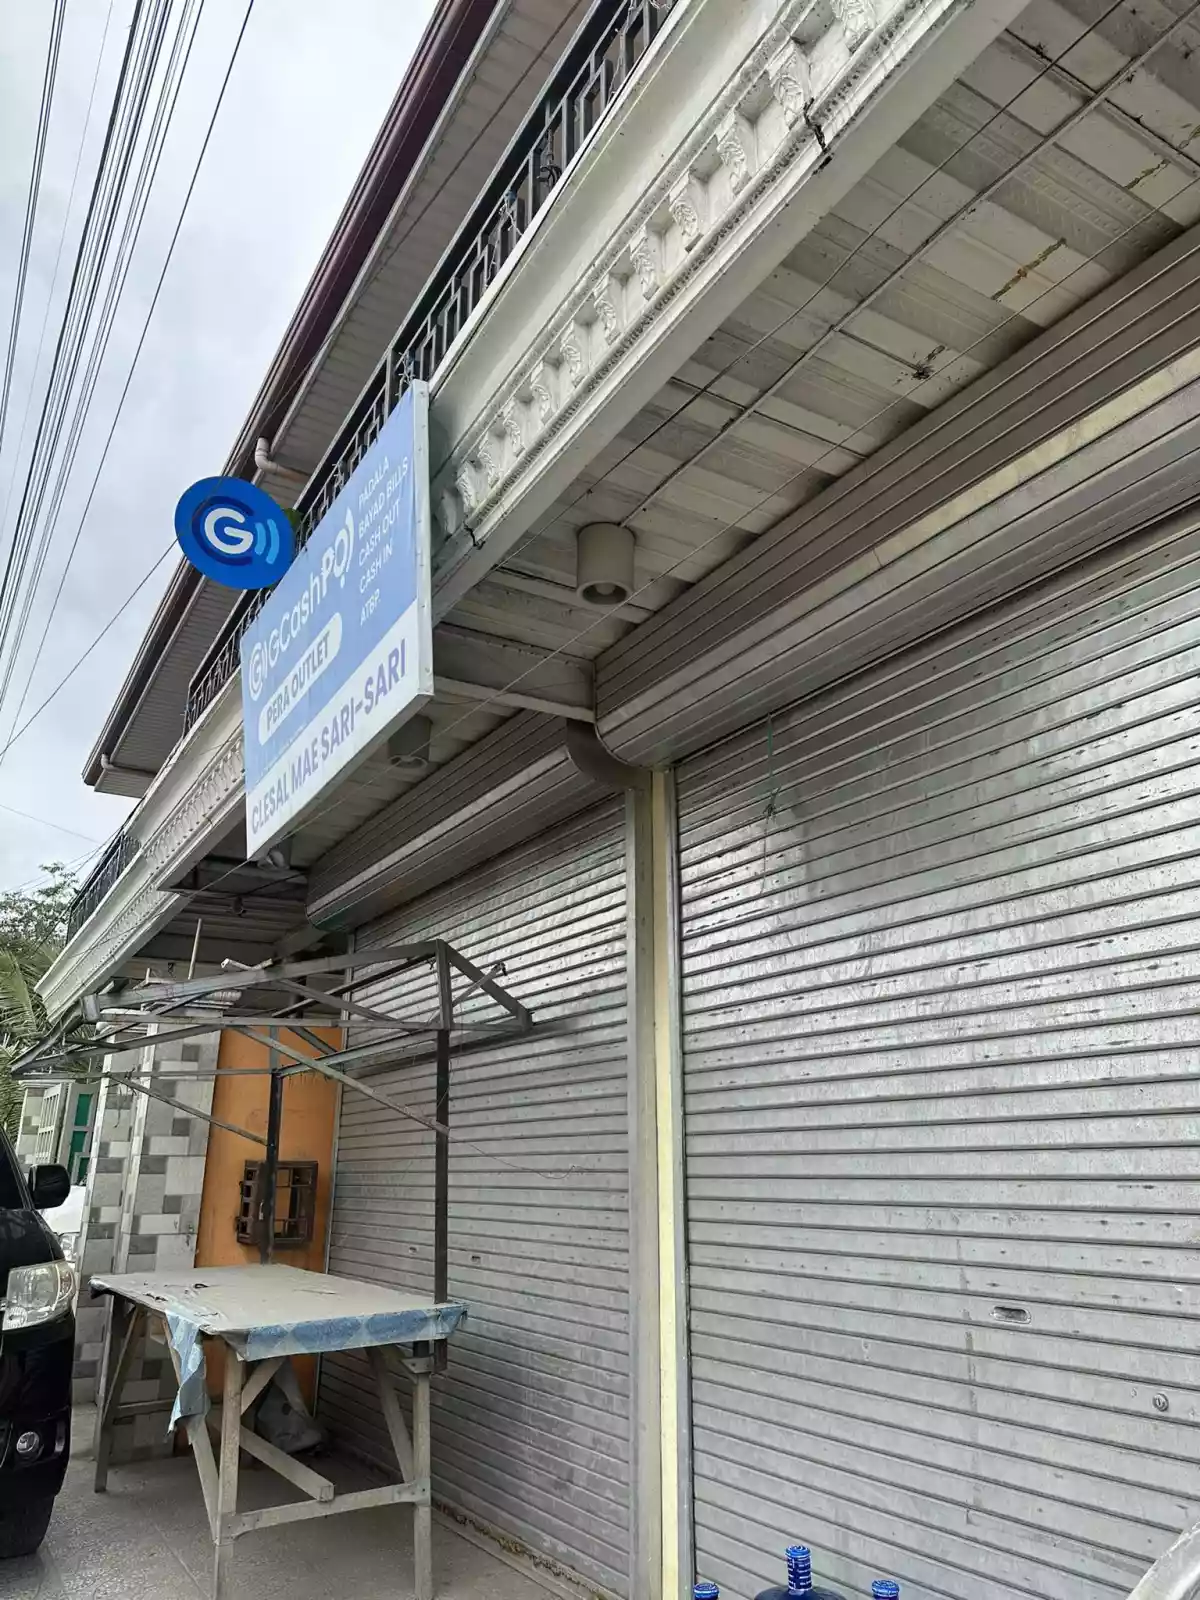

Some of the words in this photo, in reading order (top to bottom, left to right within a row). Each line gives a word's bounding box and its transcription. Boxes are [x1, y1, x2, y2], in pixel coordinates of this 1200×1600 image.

[358, 455, 389, 509] PADALA
[358, 492, 386, 540] BAYAD
[386, 456, 409, 498] BILLS
[358, 530, 381, 566] CASH
[382, 498, 400, 534] OUT
[359, 558, 382, 594] CASH
[383, 542, 393, 563] IN
[266, 691, 290, 732] PERA
[291, 633, 330, 698] OUTLET
[251, 772, 290, 835] CLESAL
[291, 737, 319, 794] MAE
[321, 638, 406, 761] SARI-SARI
